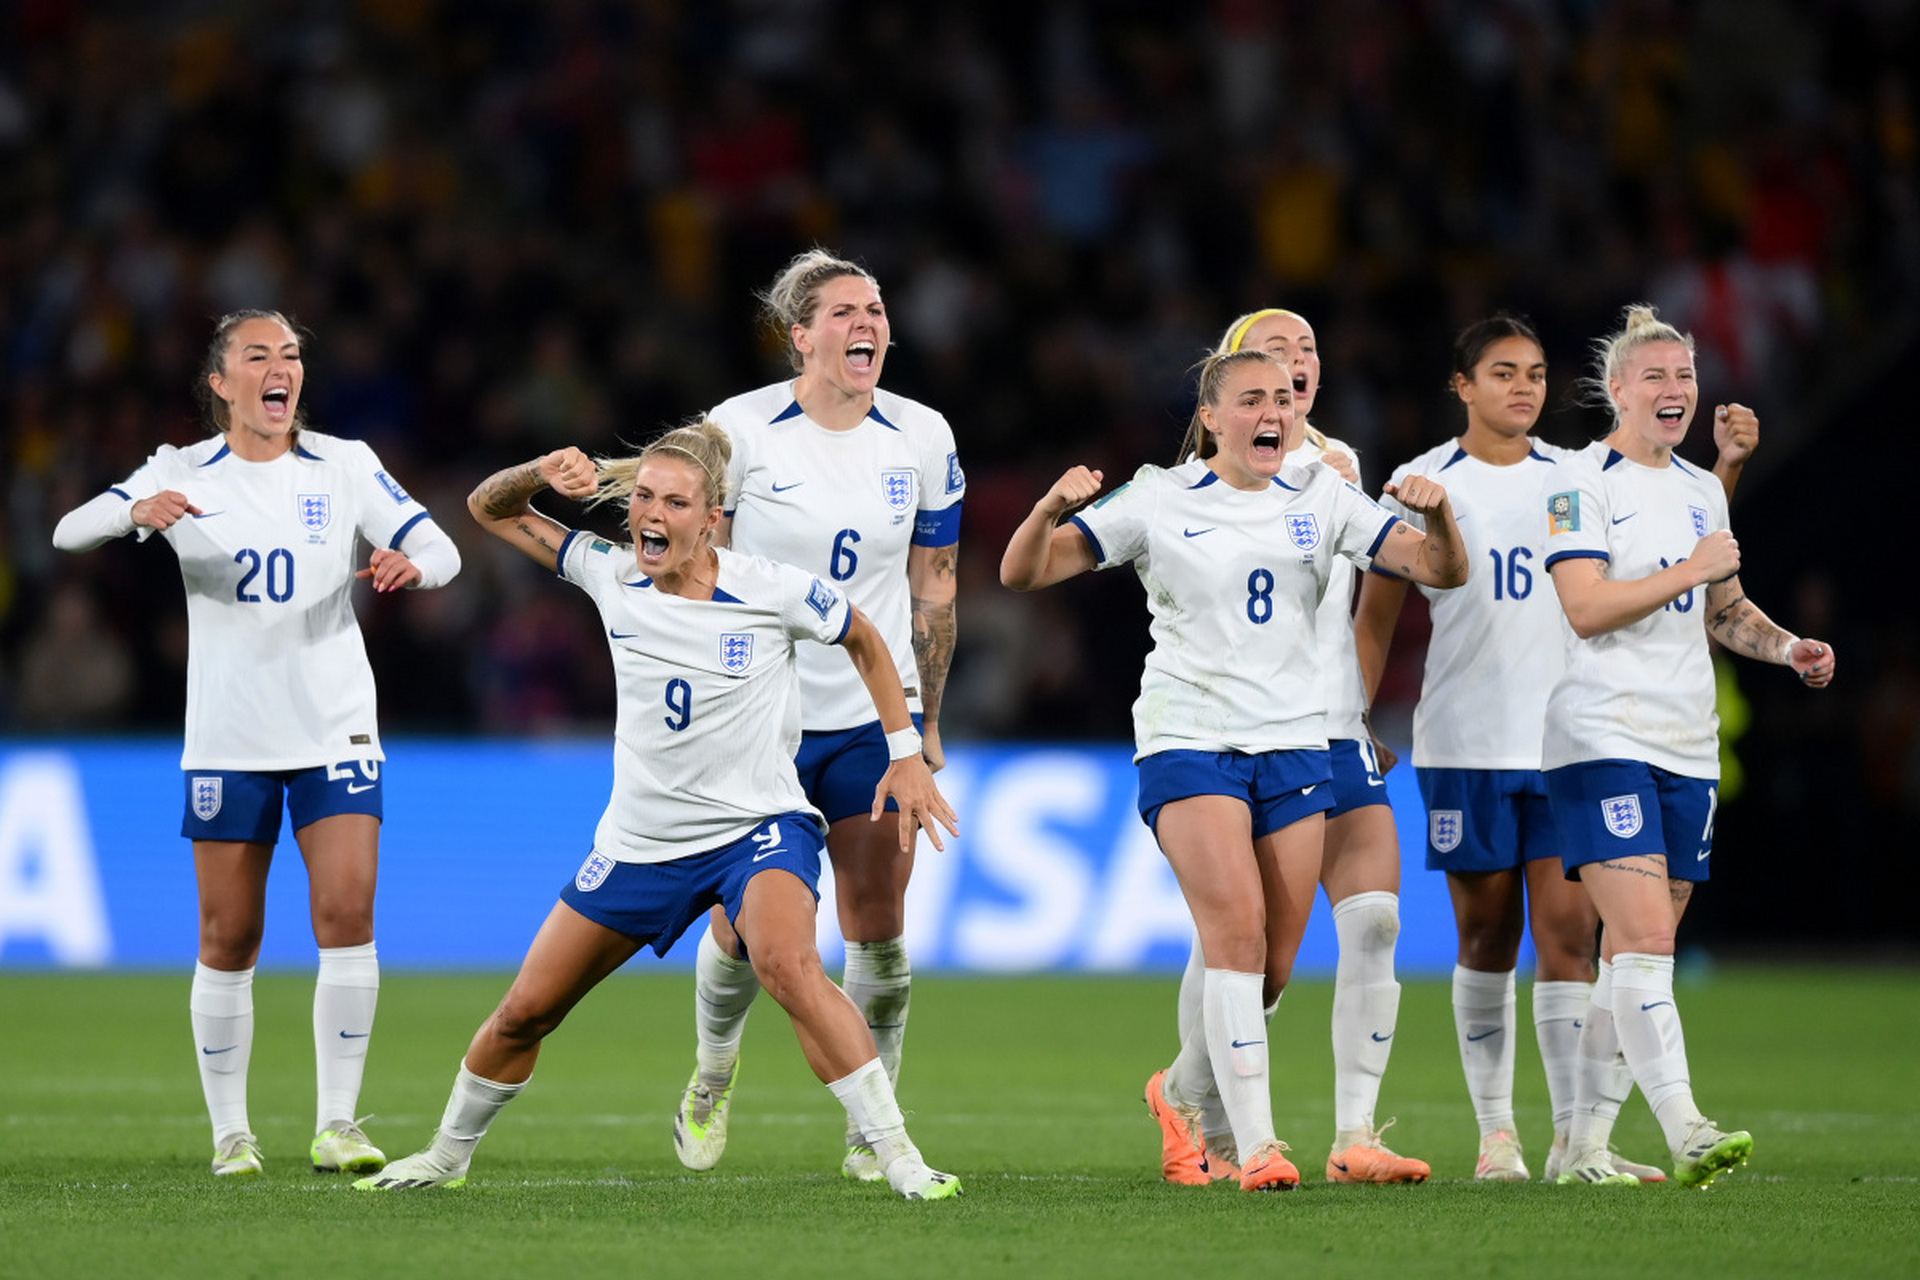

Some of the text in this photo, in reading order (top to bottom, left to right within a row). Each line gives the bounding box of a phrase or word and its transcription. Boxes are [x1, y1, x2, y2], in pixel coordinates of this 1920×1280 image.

[236, 549, 295, 602] 20
[830, 529, 861, 581] 6
[1490, 547, 1533, 600] 16
[1248, 569, 1274, 624] 8
[665, 678, 692, 731] 9
